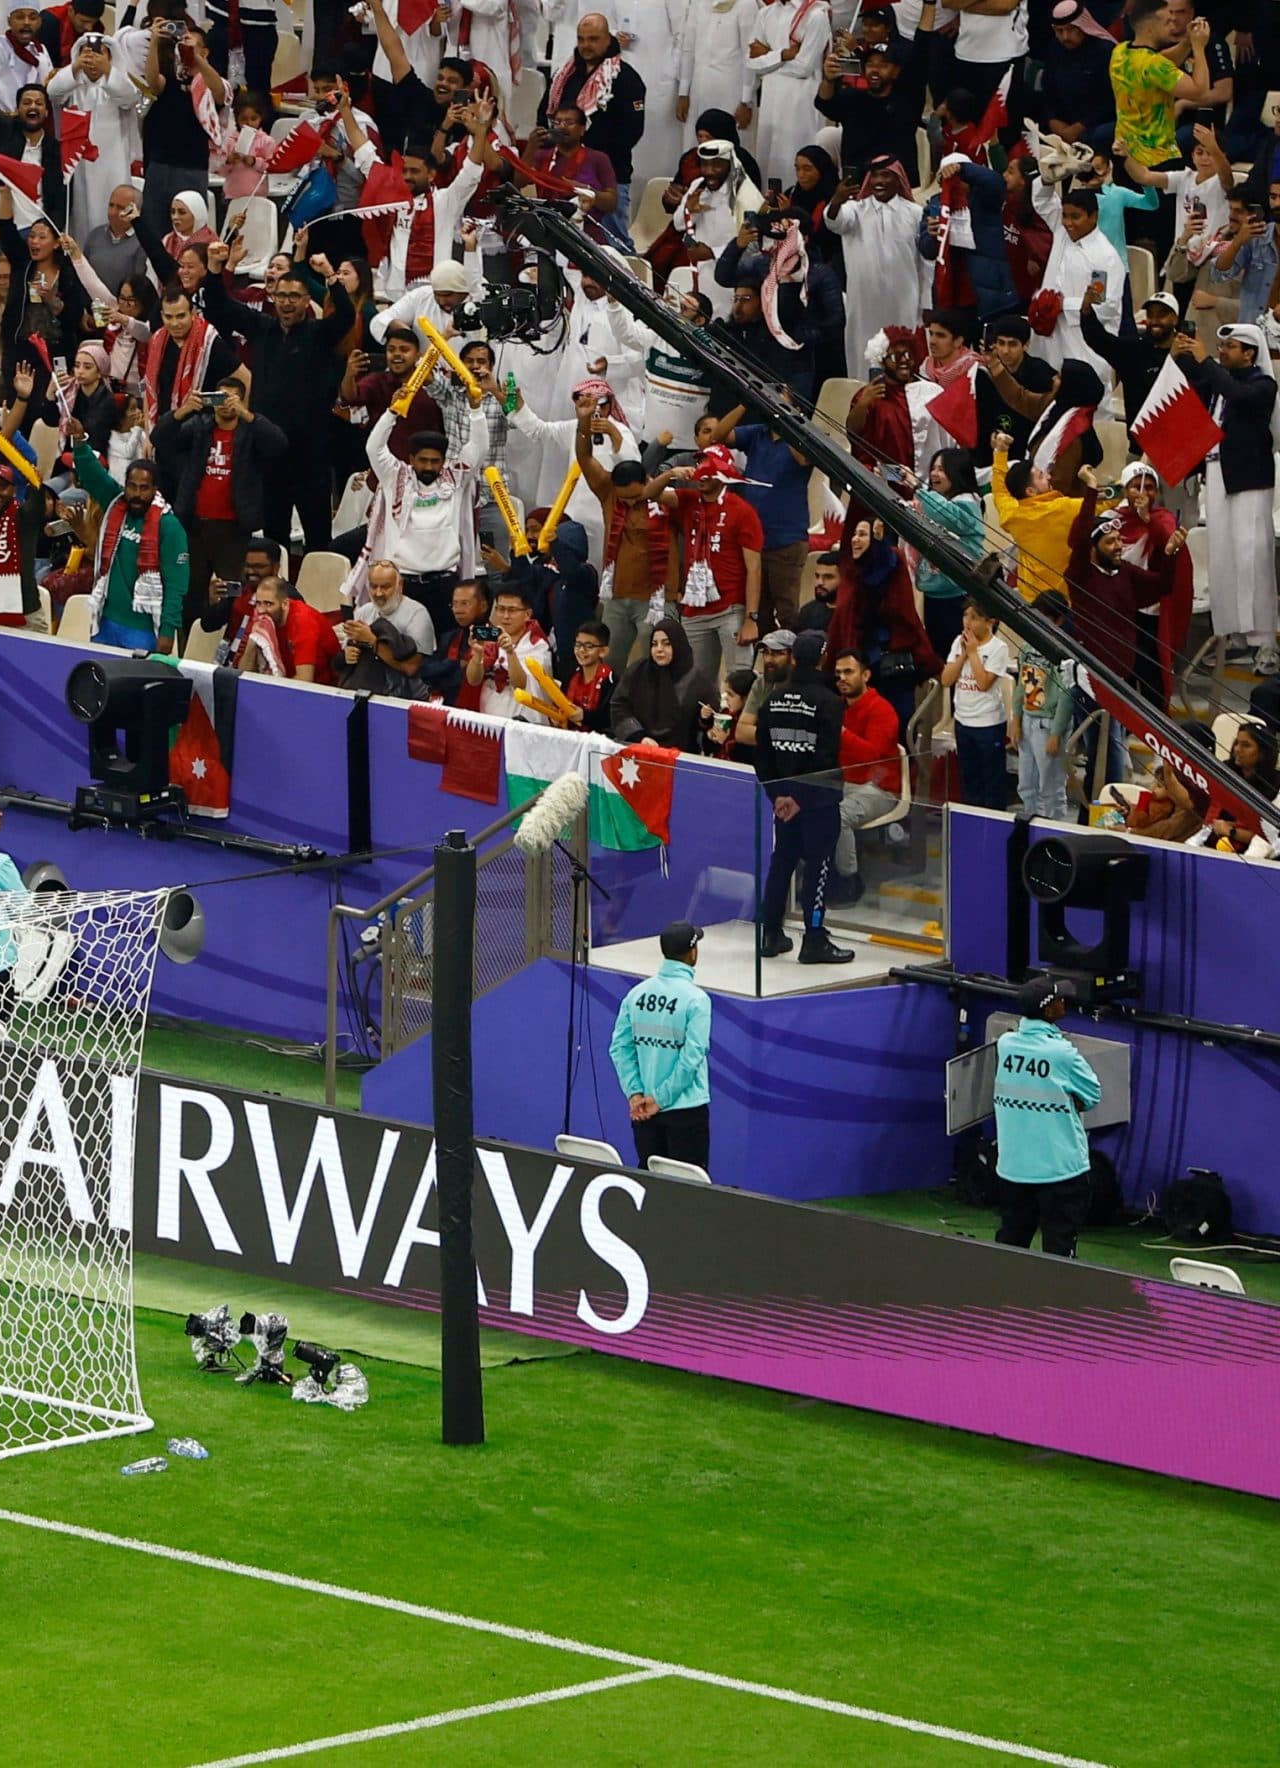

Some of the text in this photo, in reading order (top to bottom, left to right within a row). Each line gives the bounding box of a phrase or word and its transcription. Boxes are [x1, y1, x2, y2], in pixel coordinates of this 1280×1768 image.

[1144, 732, 1210, 795] QATAR
[635, 992, 678, 1015] 4894
[1003, 1053, 1051, 1079] 4740
